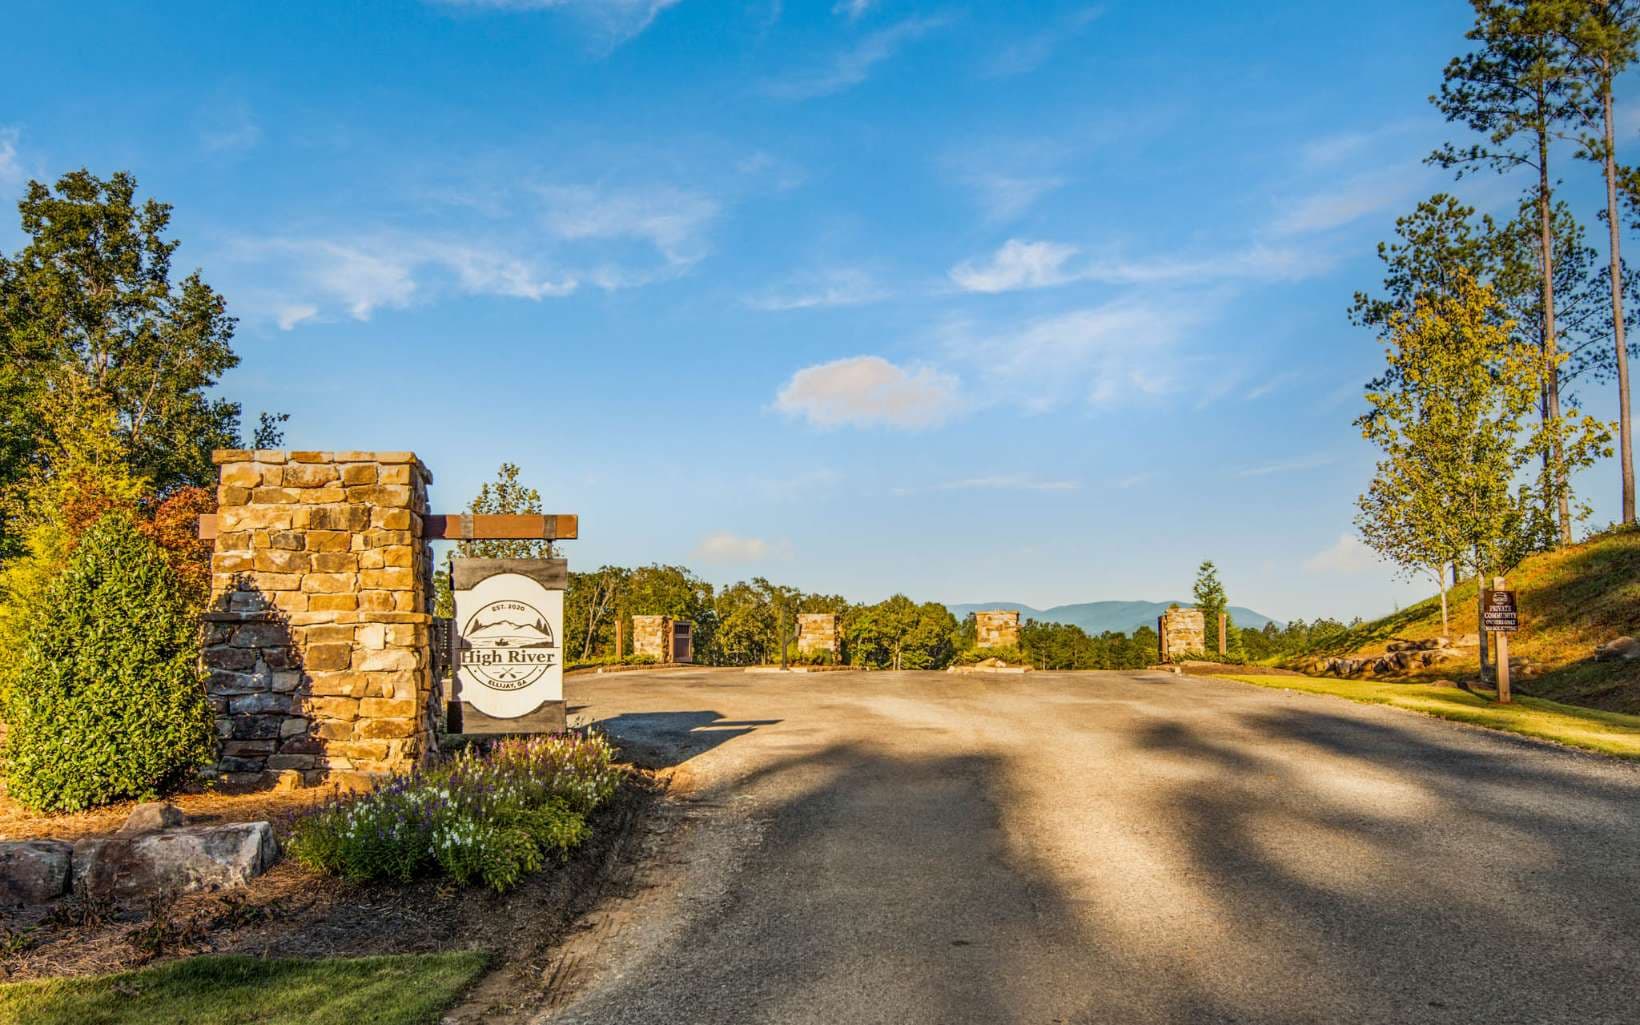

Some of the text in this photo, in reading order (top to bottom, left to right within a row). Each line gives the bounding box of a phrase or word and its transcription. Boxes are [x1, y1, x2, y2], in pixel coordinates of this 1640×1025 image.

[492, 603, 525, 612] EST. 2020
[461, 650, 555, 666] High River
[488, 679, 527, 689] ELLIJAY, GA
